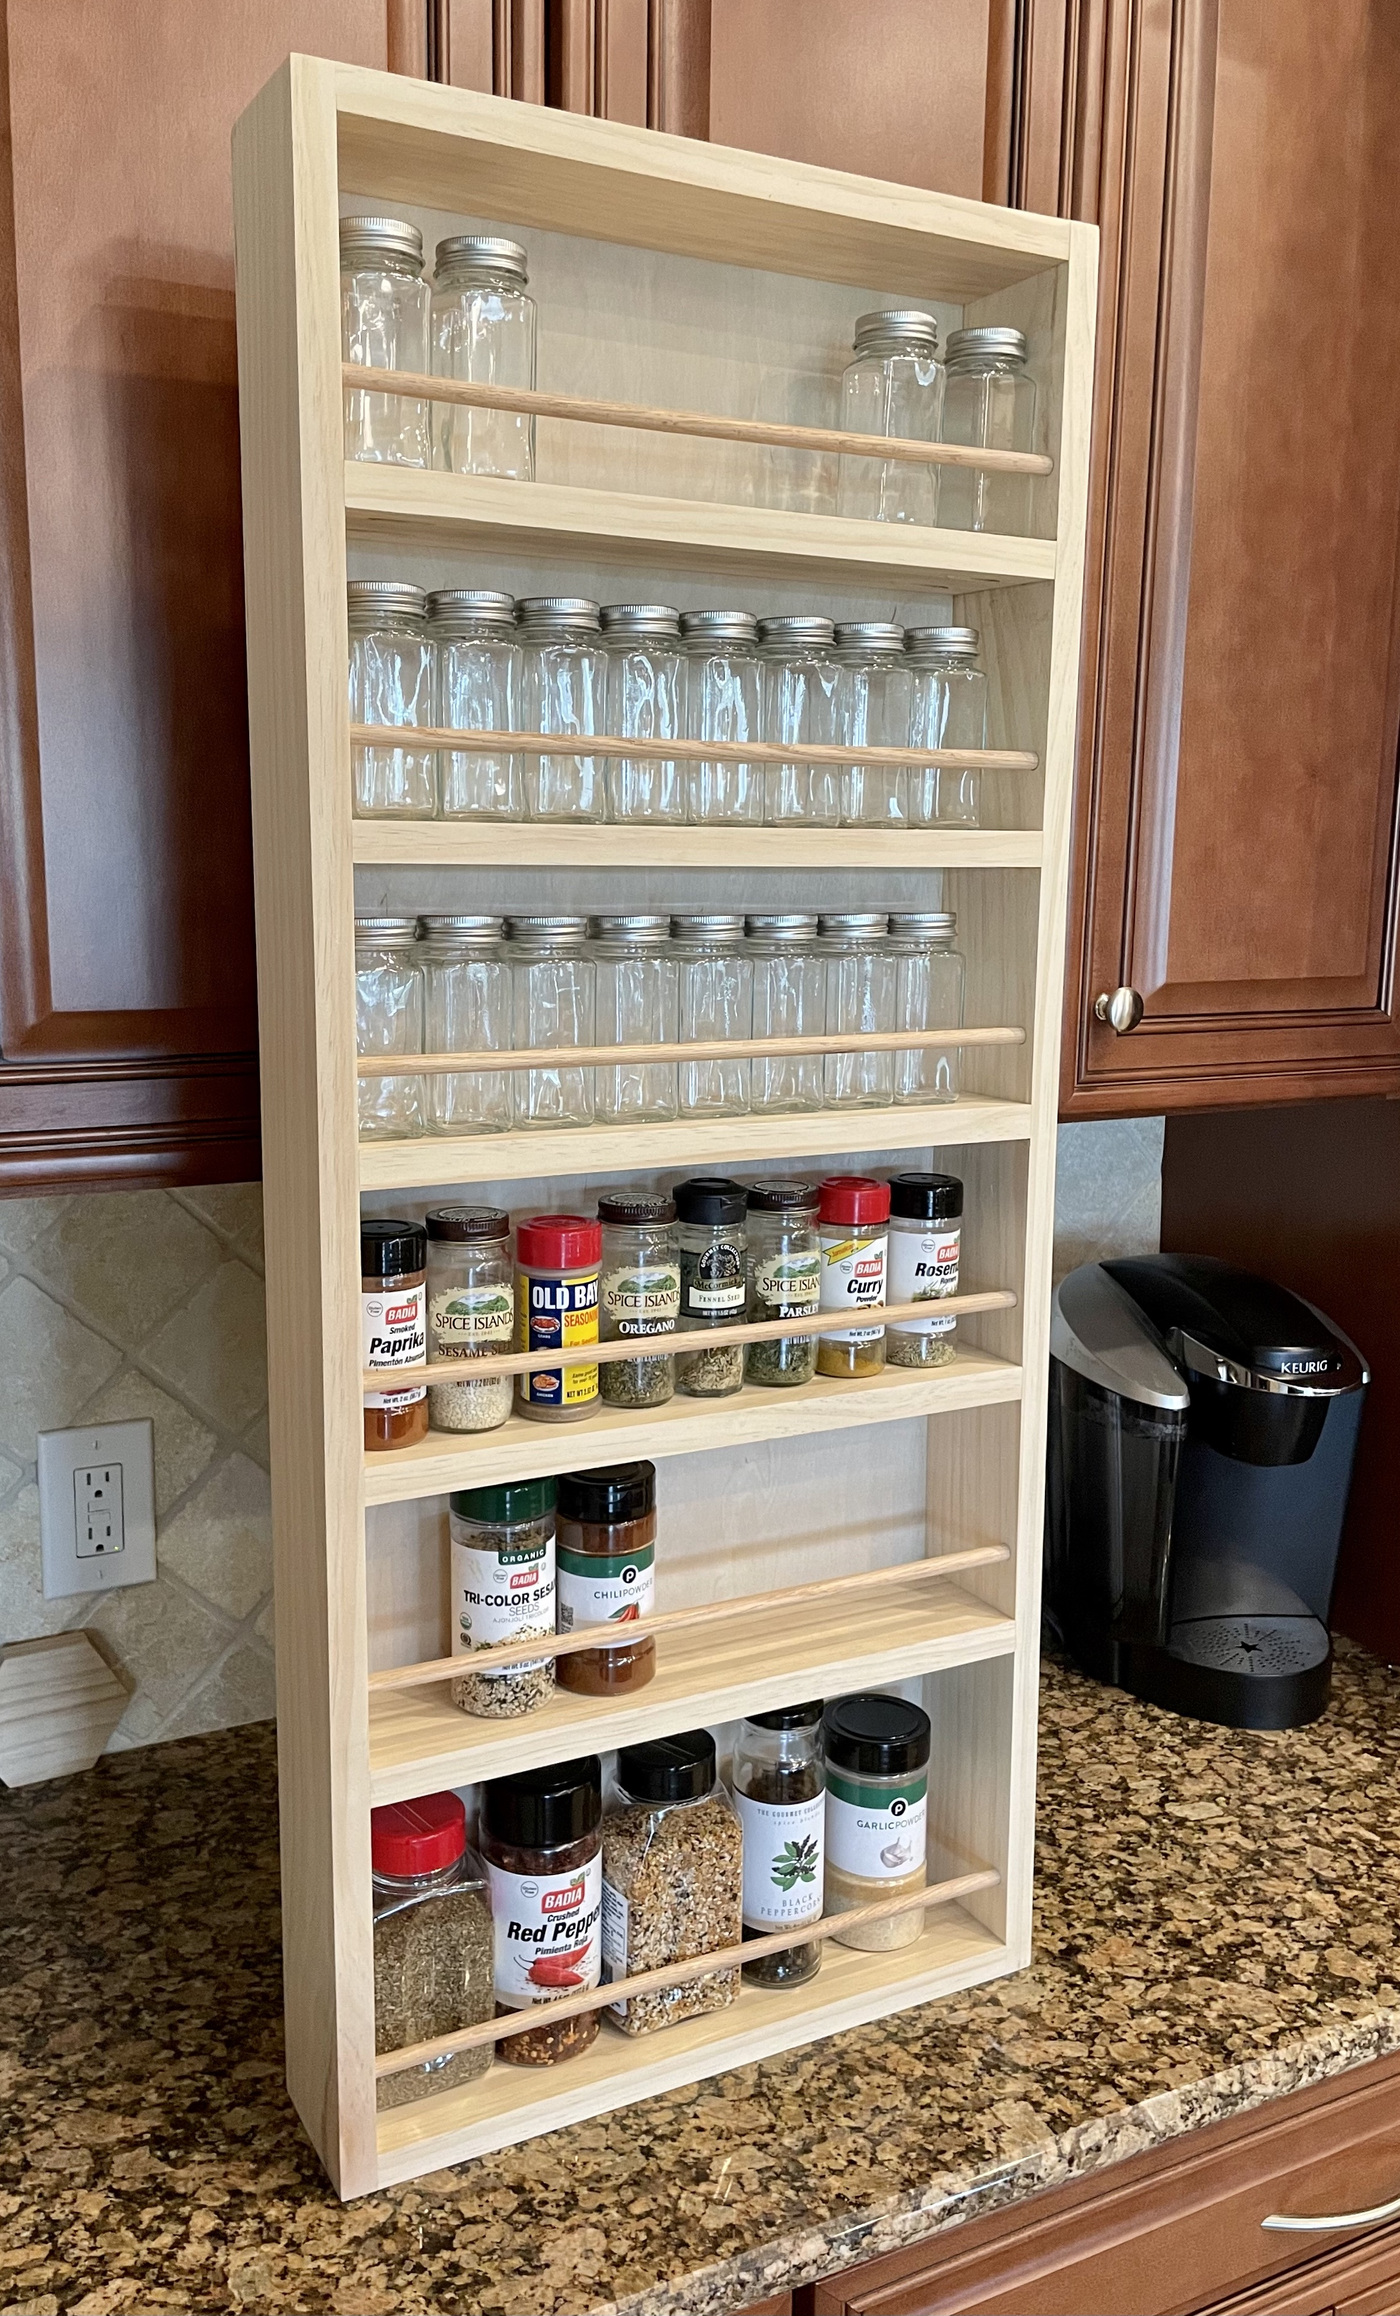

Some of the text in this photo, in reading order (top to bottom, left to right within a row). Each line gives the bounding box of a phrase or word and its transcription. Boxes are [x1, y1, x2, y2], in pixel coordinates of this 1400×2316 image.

[701, 1245, 719, 1268] GOURMET
[856, 1262, 881, 1274] BADIA
[697, 1278, 737, 1290] McCormick
[762, 1277, 797, 1292] SPICE
[847, 1279, 884, 1294] Curry
[532, 1280, 598, 1310] OLD BAY
[607, 1290, 642, 1308] SPICE
[698, 1294, 726, 1303] FENNEL
[856, 1295, 878, 1303] Powder
[387, 1305, 417, 1321] BADIA
[389, 1322, 416, 1335] Smoked
[435, 1312, 471, 1330] SPICE
[618, 1319, 675, 1334] OREGANO
[369, 1332, 424, 1357] Paprika
[438, 1343, 488, 1359] SESAME
[1281, 1359, 1328, 1374] KEURIG
[502, 1549, 545, 1563] ORGANIC
[511, 1572, 538, 1587] BADIA
[463, 1589, 530, 1607] TRI-COLOR
[508, 1602, 541, 1617] SEEDS
[757, 1808, 770, 1817] THE
[772, 1809, 802, 1818] GOURMET
[544, 1887, 583, 1909] BADIA
[782, 1893, 813, 1907] BLACK
[547, 1907, 580, 1923] Crushed
[507, 1920, 548, 1943] Red
[535, 1943, 572, 1956] Pimienta
